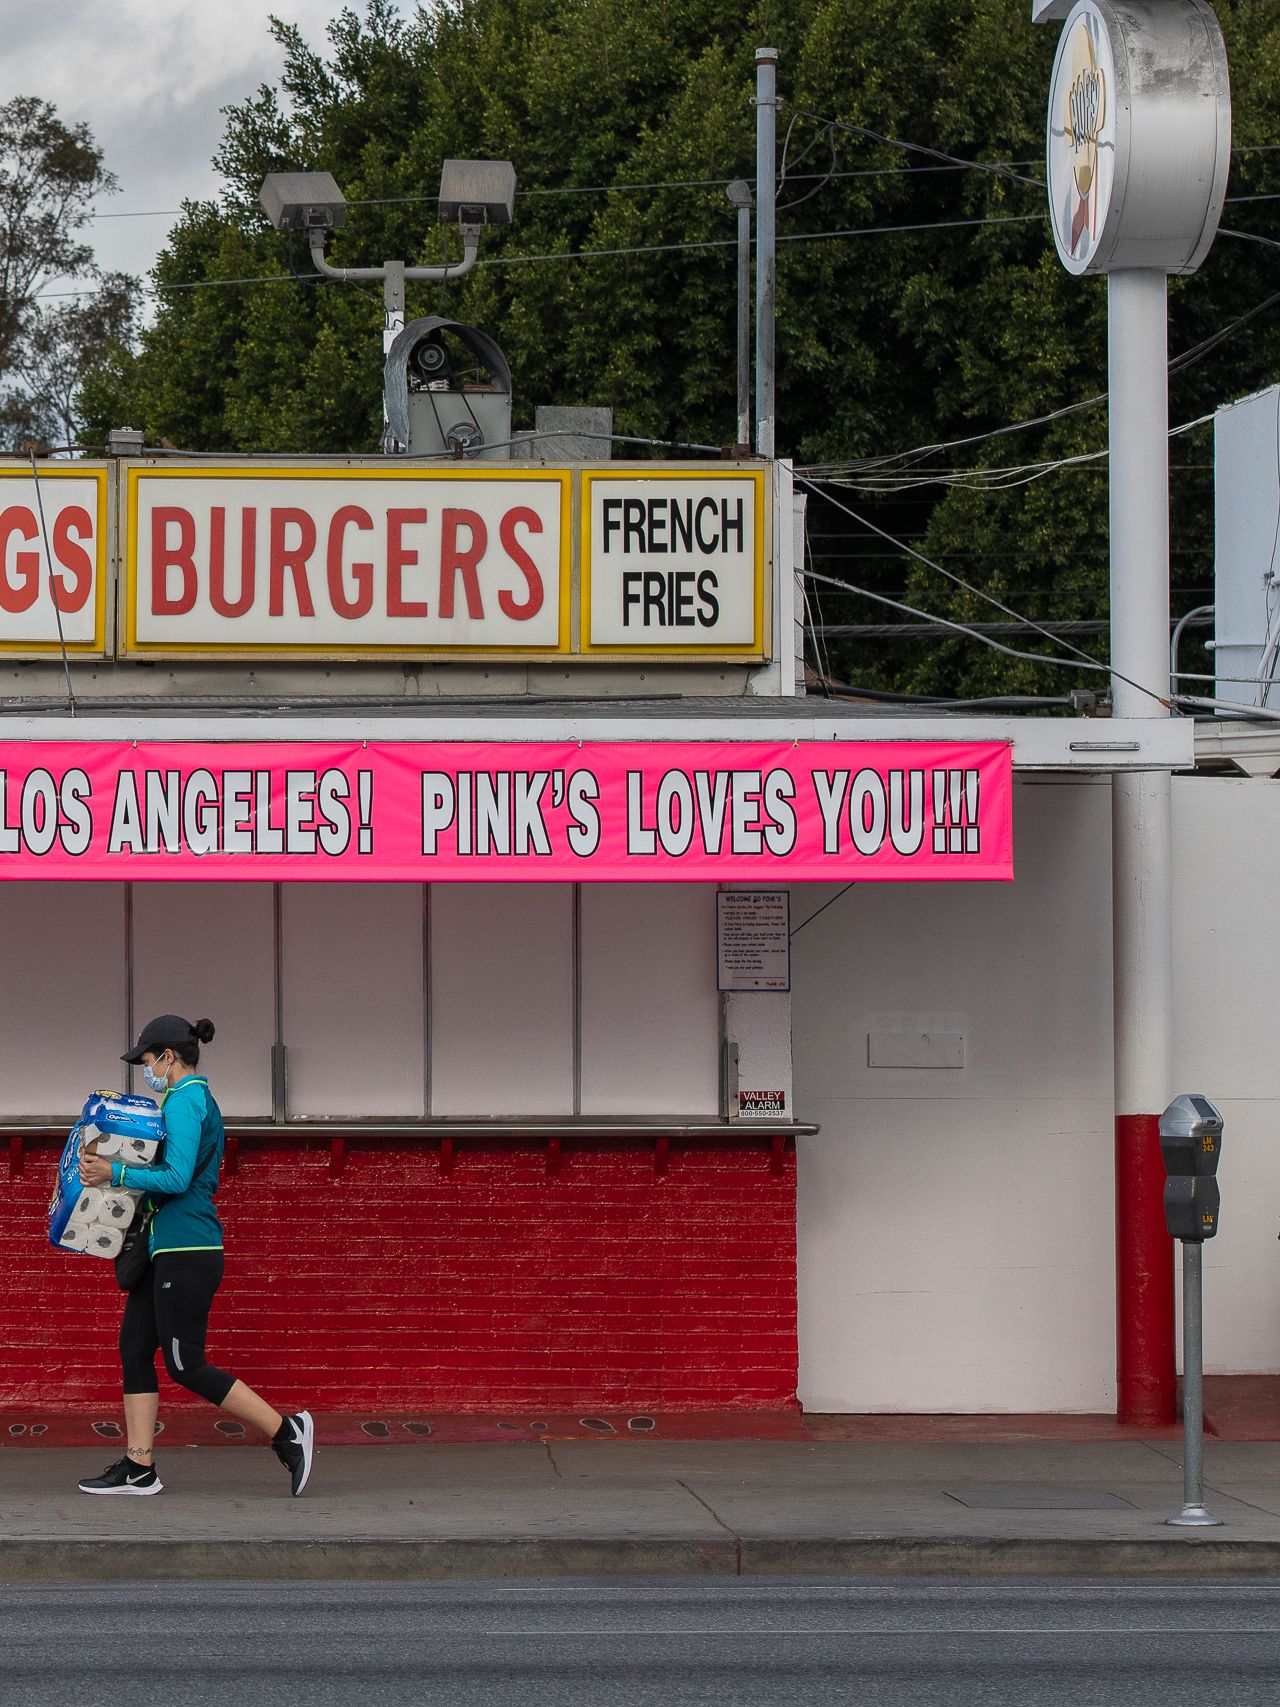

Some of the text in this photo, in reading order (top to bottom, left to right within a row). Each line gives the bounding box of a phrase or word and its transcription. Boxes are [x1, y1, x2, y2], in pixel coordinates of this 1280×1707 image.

[602, 496, 745, 555] FRENCH
[151, 504, 545, 621] BURGERS
[622, 569, 720, 628] FRIES
[107, 767, 374, 857] ANGELES!
[420, 768, 602, 858] PINK'S
[626, 767, 797, 857] LOVES
[812, 767, 980, 857] YOU!!!
[743, 1092, 781, 1100] VALLEY
[745, 1101, 780, 1109] ALARM
